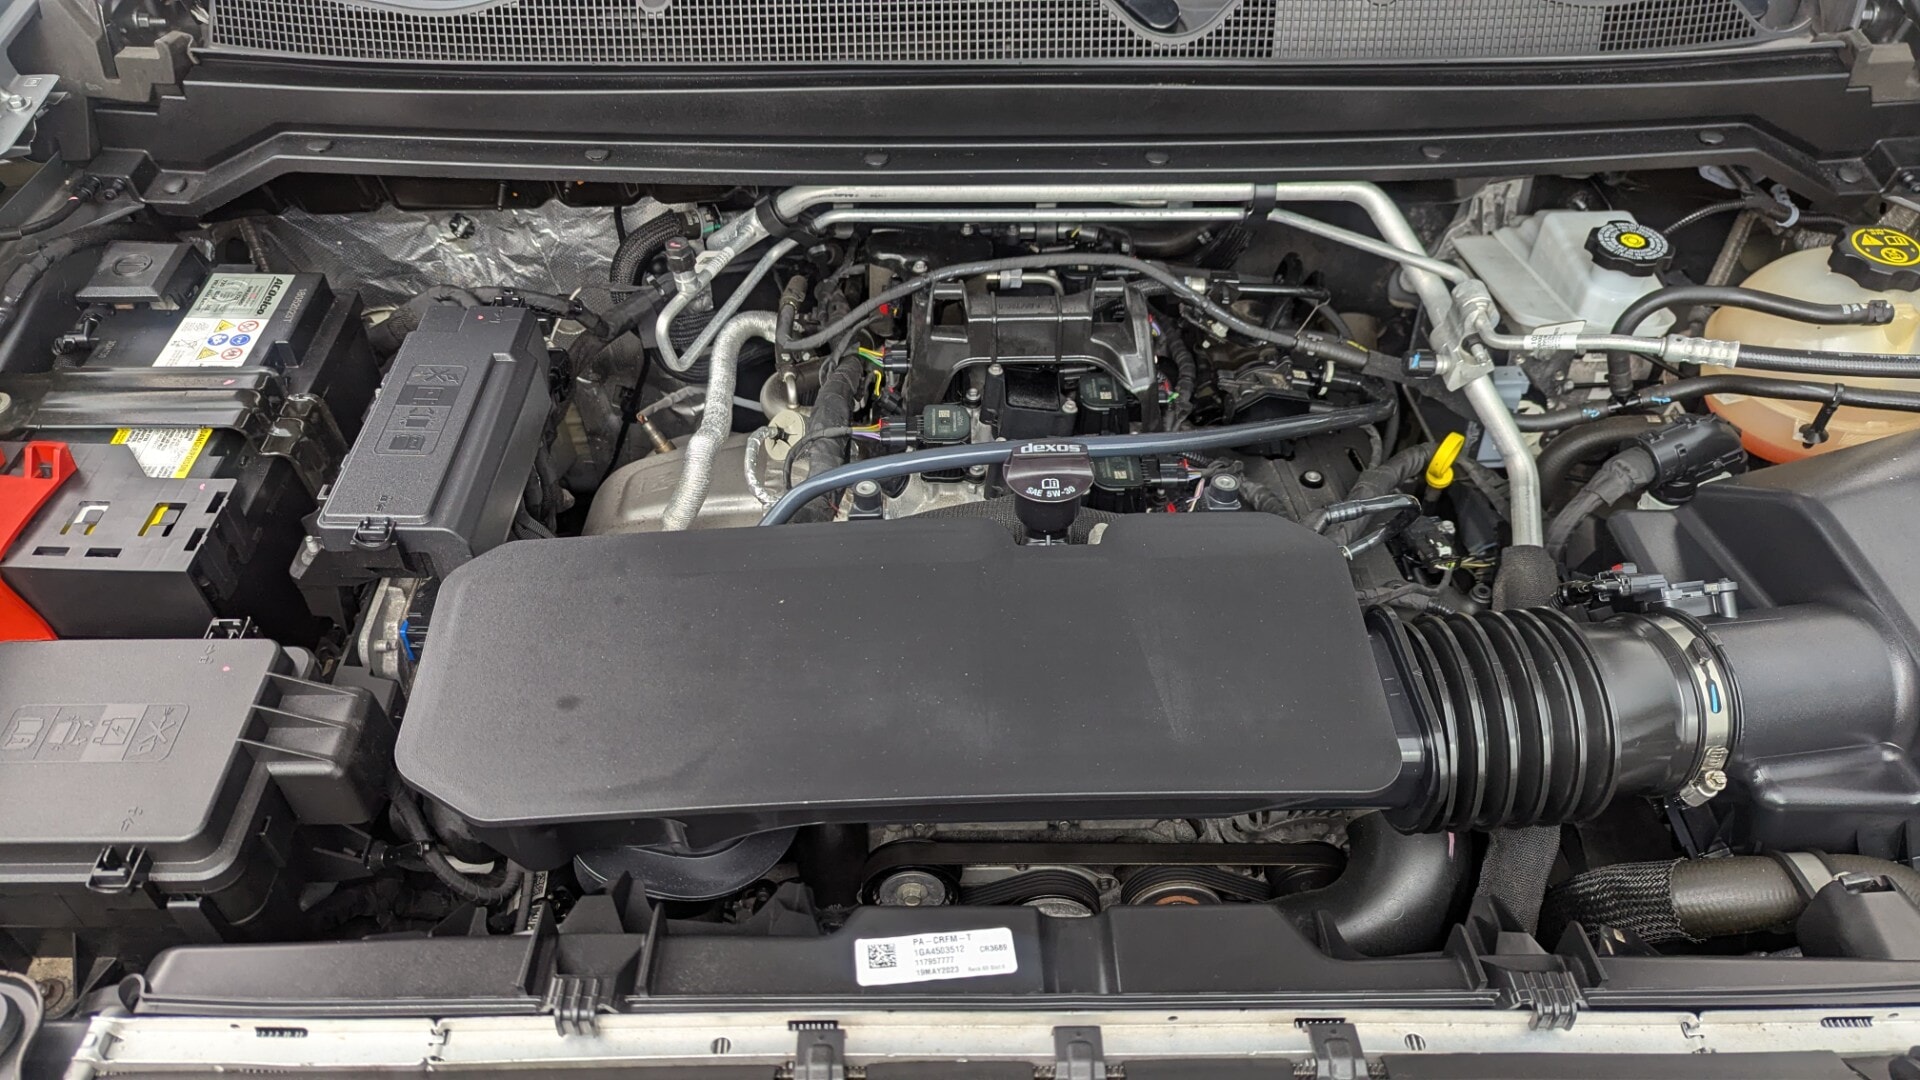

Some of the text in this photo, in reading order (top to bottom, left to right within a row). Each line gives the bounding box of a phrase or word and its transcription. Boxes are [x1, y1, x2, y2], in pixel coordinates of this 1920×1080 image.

[257, 278, 284, 315] ACDelco
[1020, 443, 1082, 454] dexos
[1026, 485, 1076, 498] SAE 5W-30
[916, 965, 960, 977] 19MAY2023
